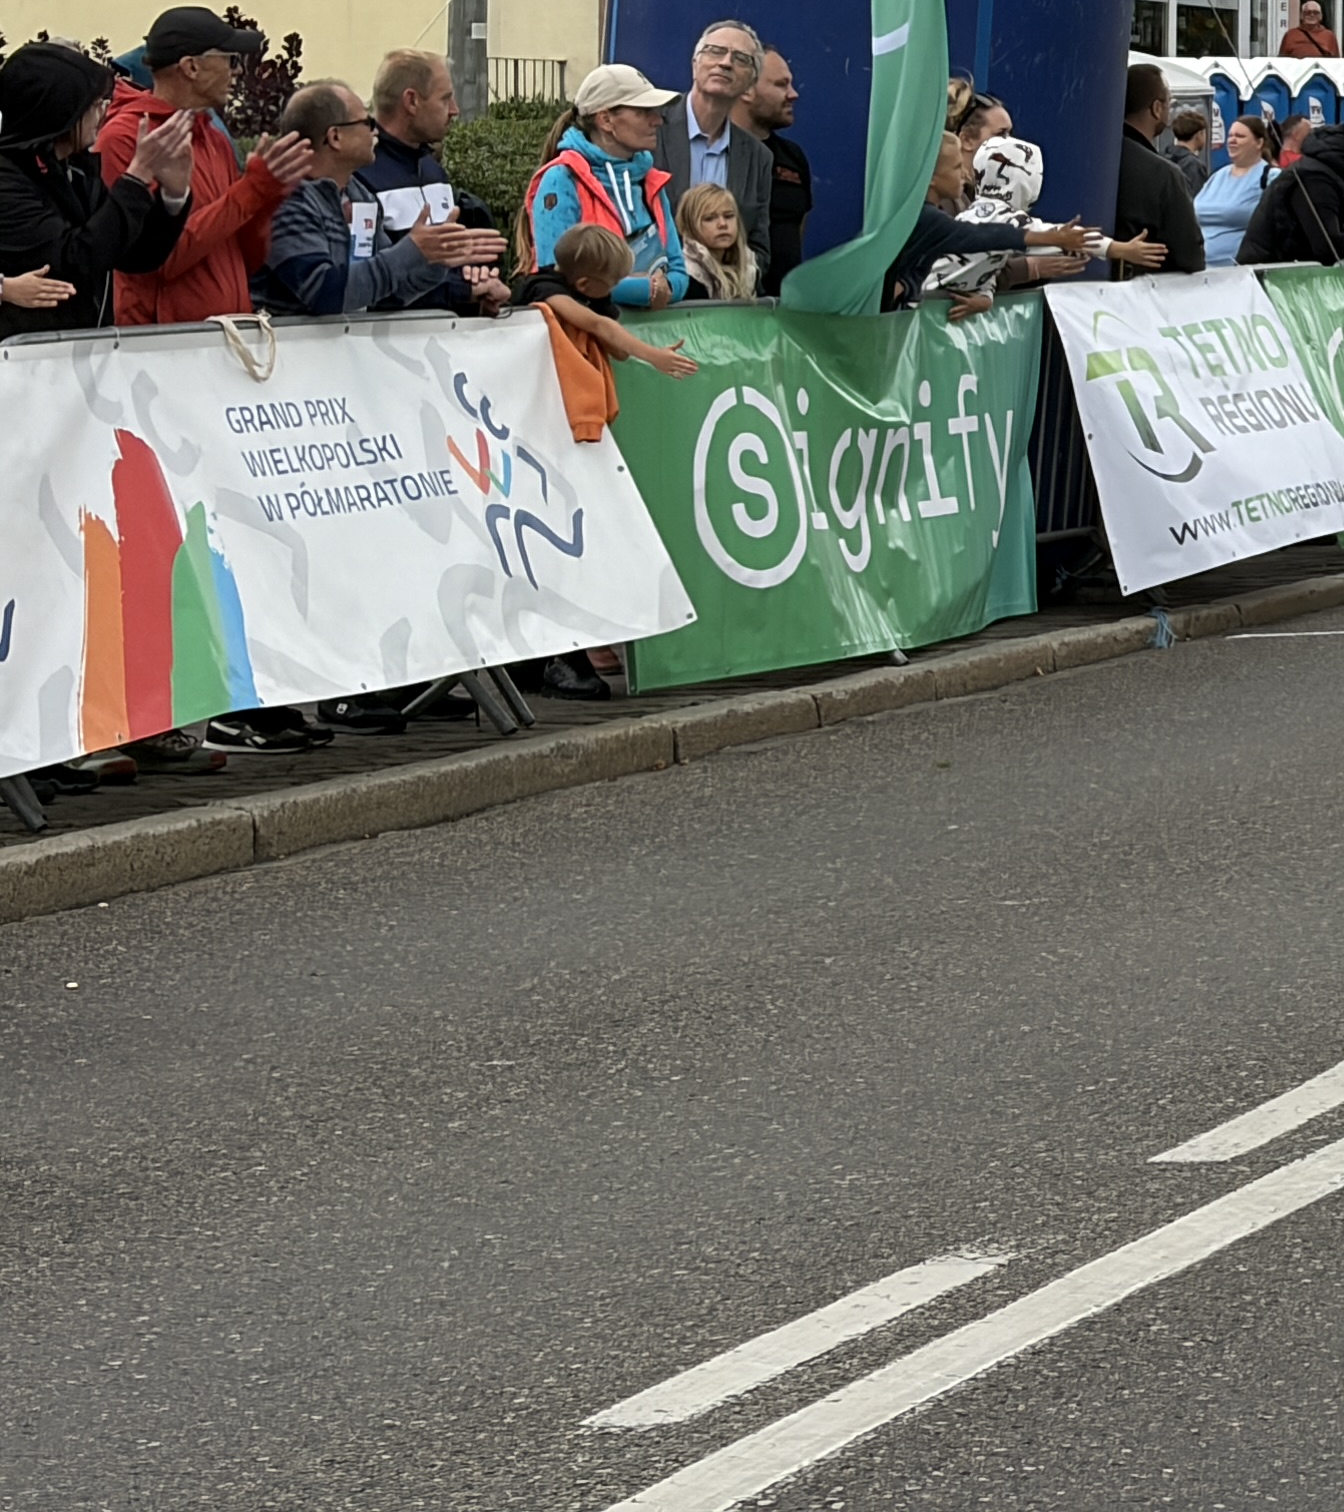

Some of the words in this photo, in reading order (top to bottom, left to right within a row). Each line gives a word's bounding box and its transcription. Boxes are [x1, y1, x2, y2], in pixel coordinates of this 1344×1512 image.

[225, 401, 304, 435] GRAND
[303, 396, 356, 428] PRIX
[1199, 382, 1320, 436] REGIONU
[241, 433, 403, 478] WIELKOPOLSKI
[257, 494, 286, 523] W
[287, 469, 459, 520] PÓŁMARATONIE
